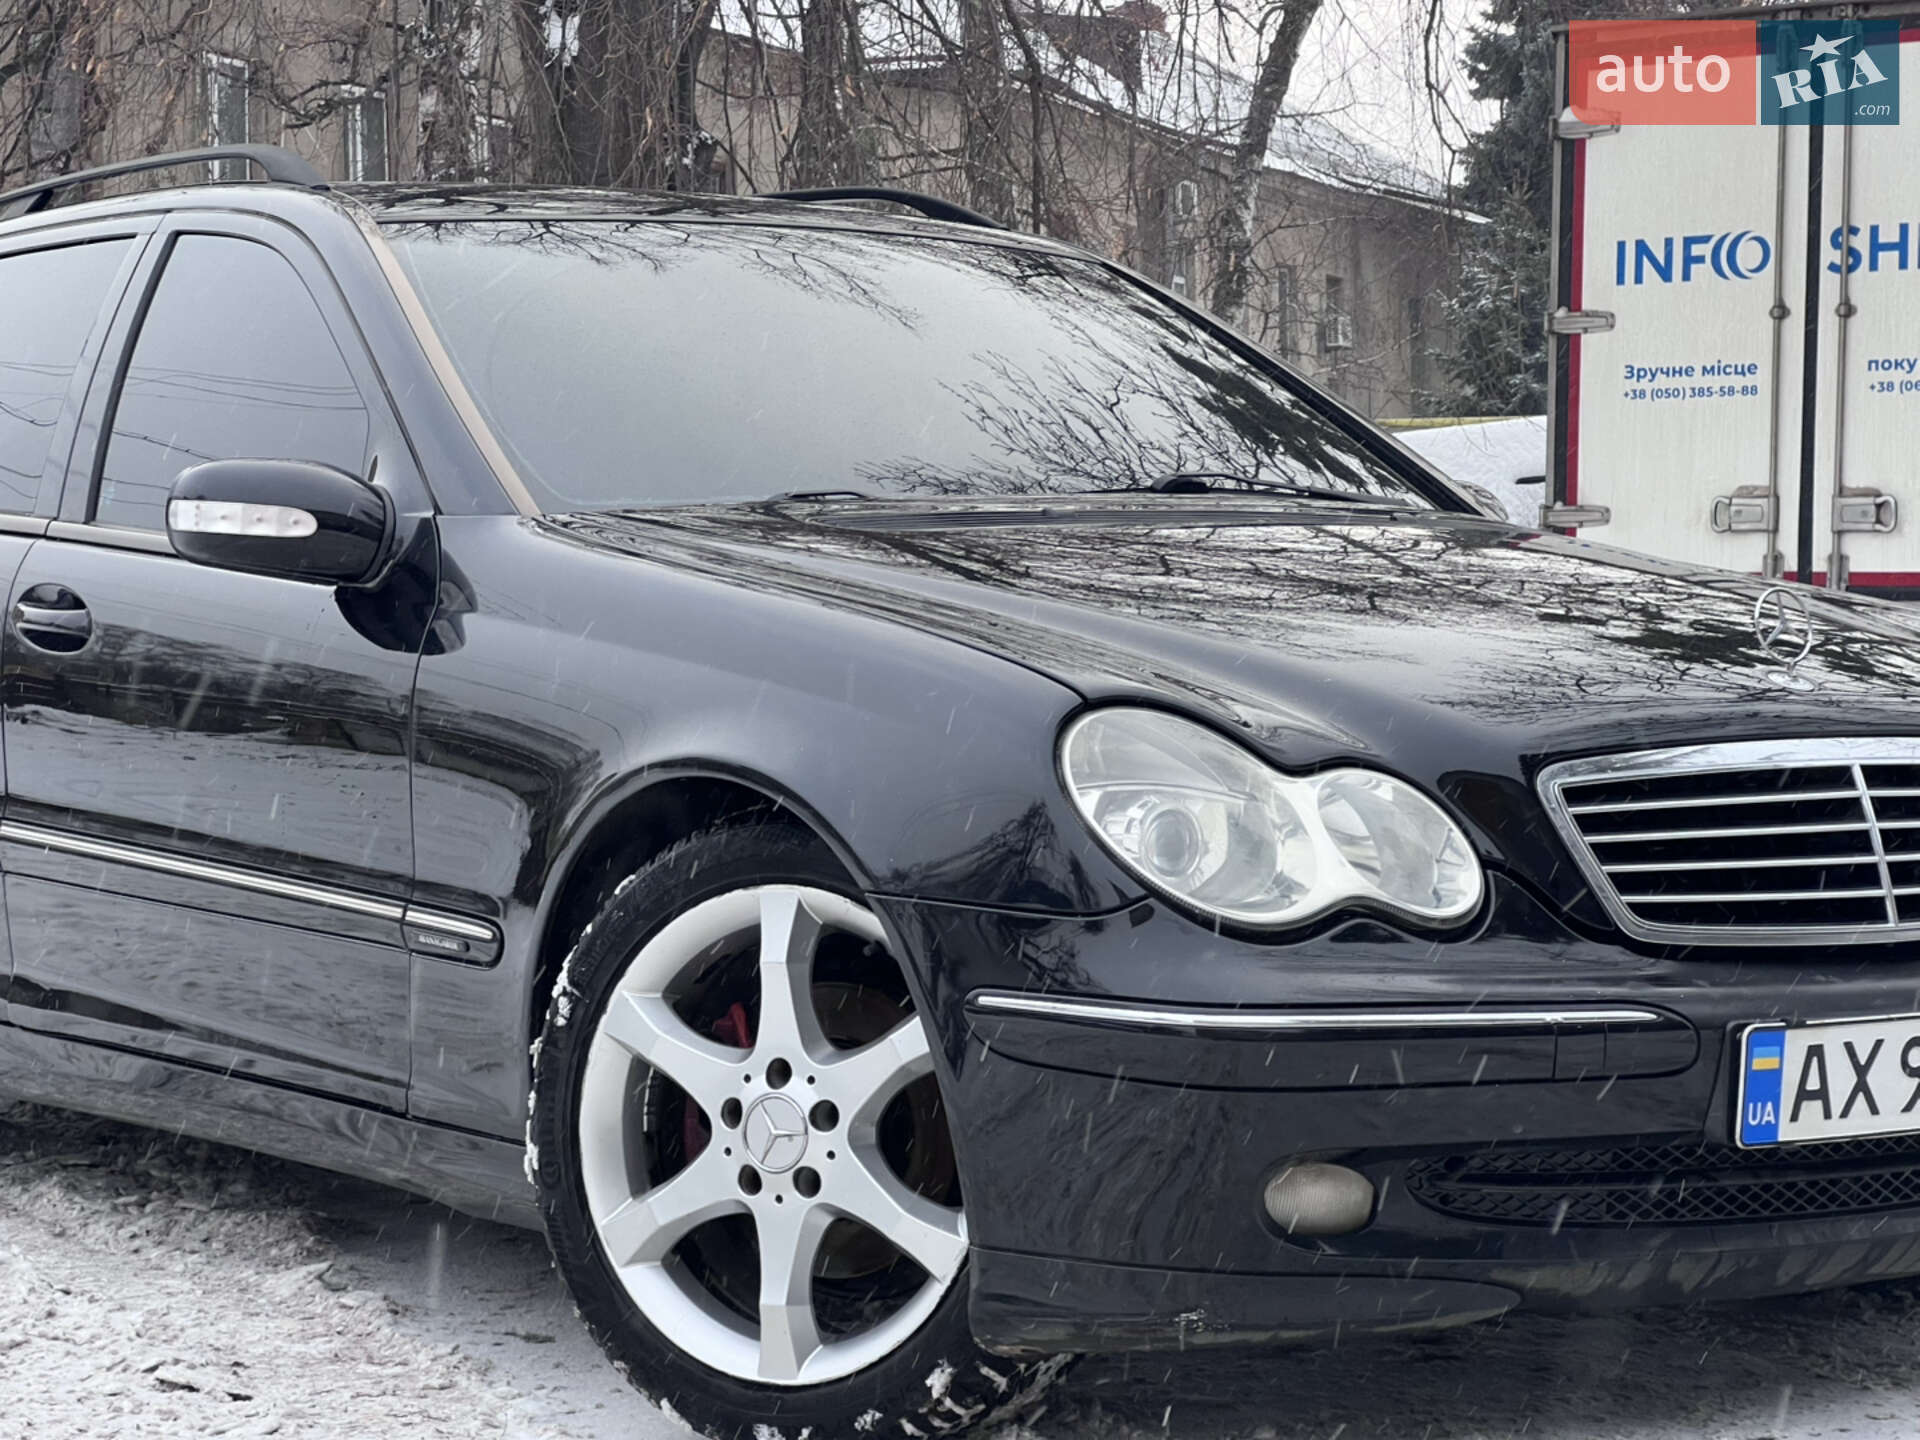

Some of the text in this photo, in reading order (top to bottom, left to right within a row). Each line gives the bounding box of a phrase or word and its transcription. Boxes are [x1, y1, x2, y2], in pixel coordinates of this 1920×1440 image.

[1827, 222, 1920, 275] SH
[1624, 357, 1918, 383] Зручне місце поку
[1623, 384, 1759, 402] +38 (050) 385-58-88
[1869, 381, 1895, 393] +38
[1789, 1038, 1885, 1123] AX
[1748, 1101, 1776, 1126] UA
